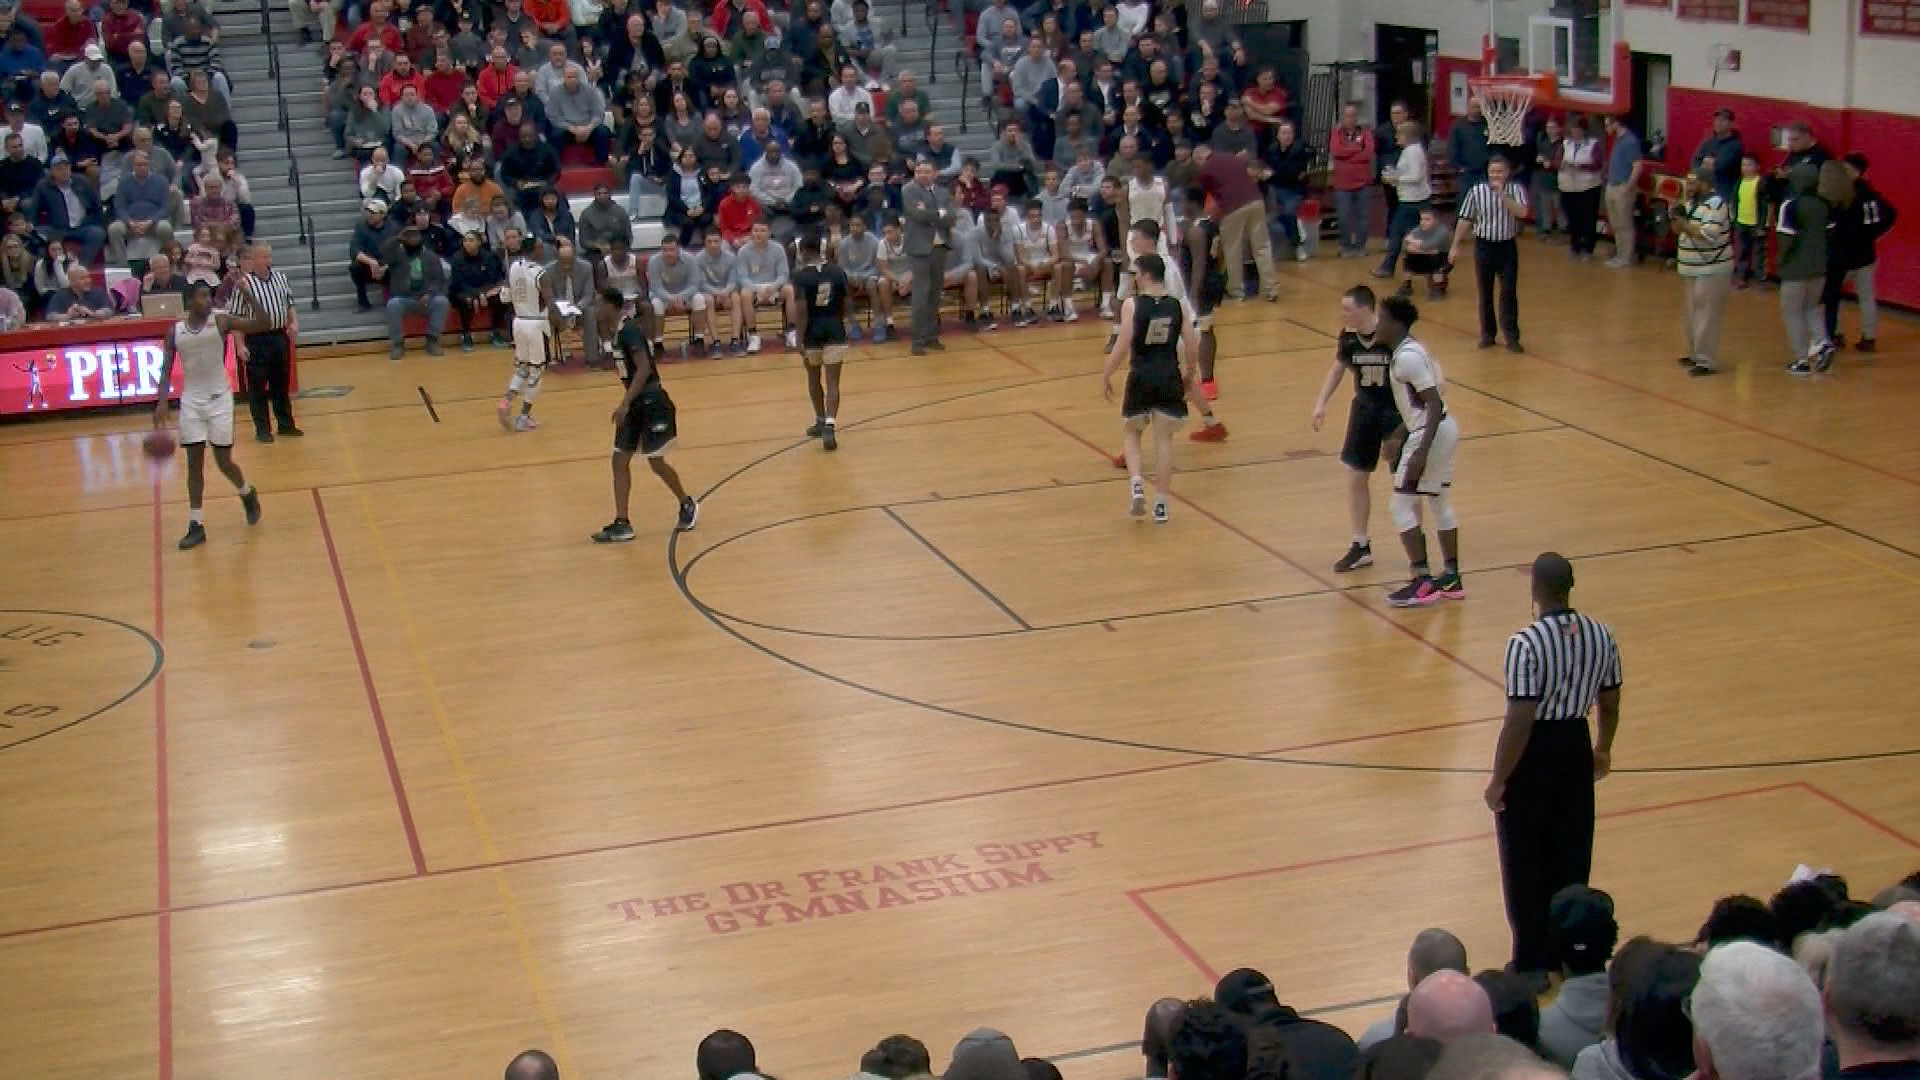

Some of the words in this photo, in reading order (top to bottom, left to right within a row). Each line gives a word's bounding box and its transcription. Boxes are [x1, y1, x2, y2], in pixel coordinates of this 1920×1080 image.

[1144, 317, 1171, 345] 15
[607, 892, 710, 922] THE
[798, 853, 970, 893] FRANK
[975, 831, 1104, 865] SIPPY
[705, 861, 1054, 934] GYMNASIUM
